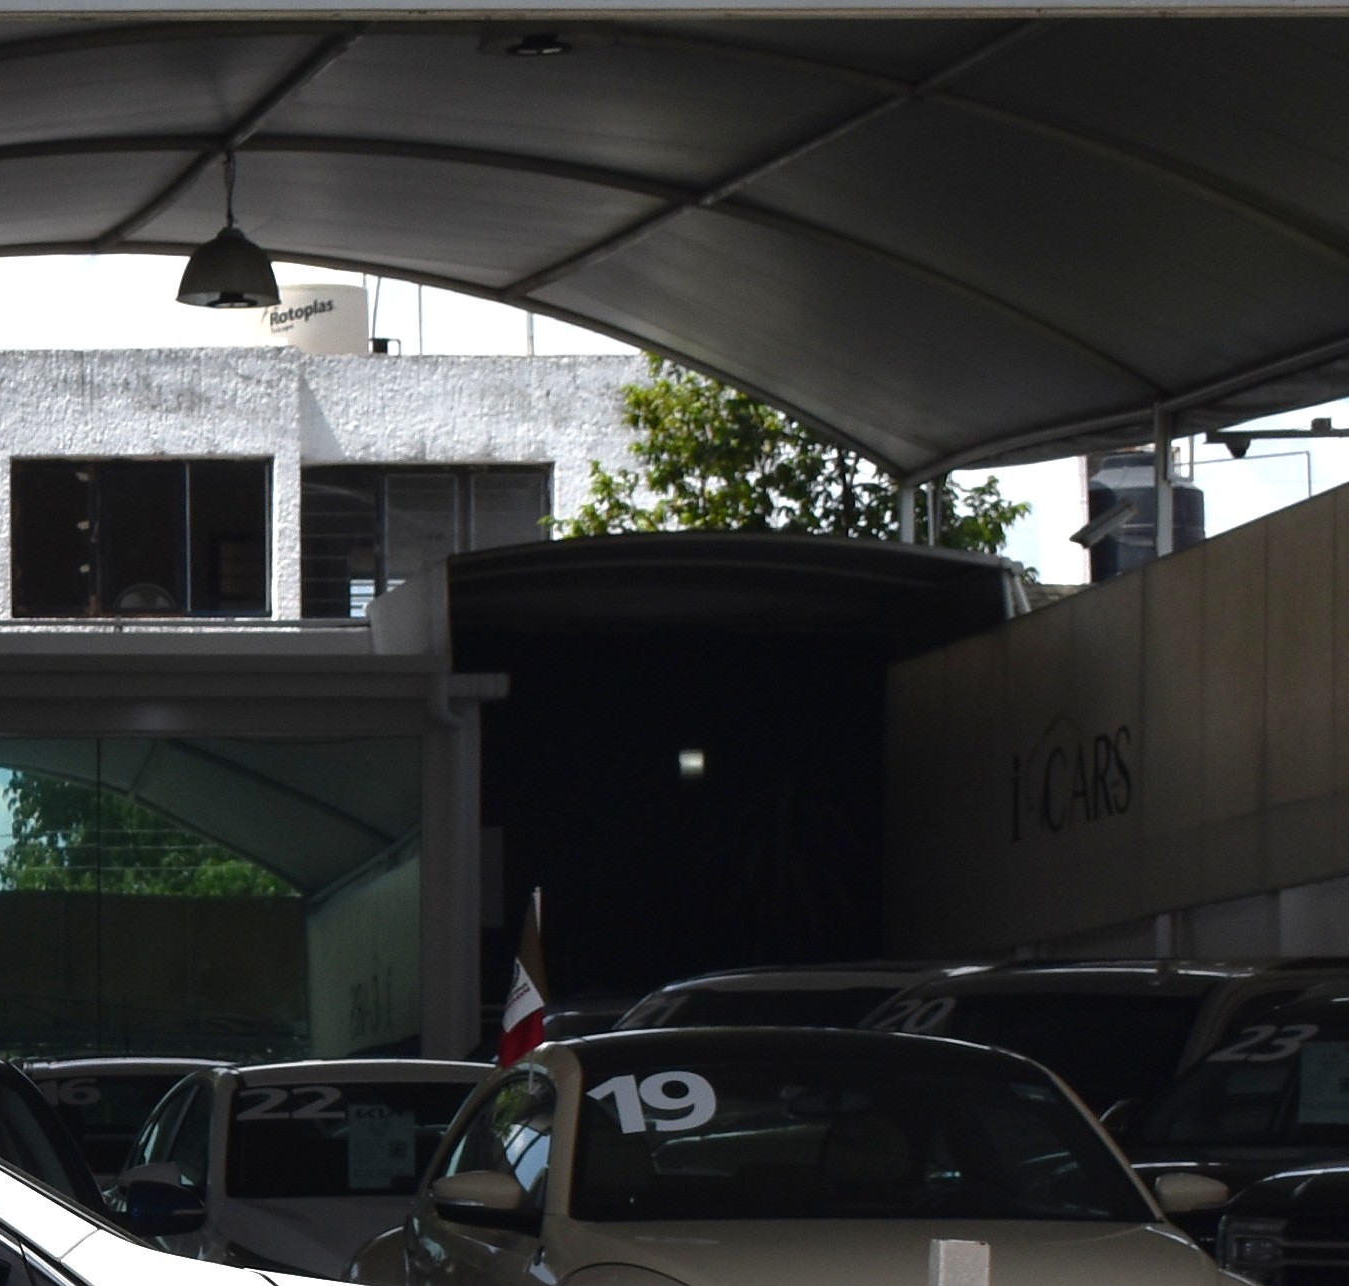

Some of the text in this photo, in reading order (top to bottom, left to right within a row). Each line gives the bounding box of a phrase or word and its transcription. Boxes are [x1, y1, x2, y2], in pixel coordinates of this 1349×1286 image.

[270, 299, 334, 326] Rotoplas
[1207, 1023, 1319, 1063] 23
[235, 1085, 346, 1121] 22
[588, 1071, 717, 1135] 19
